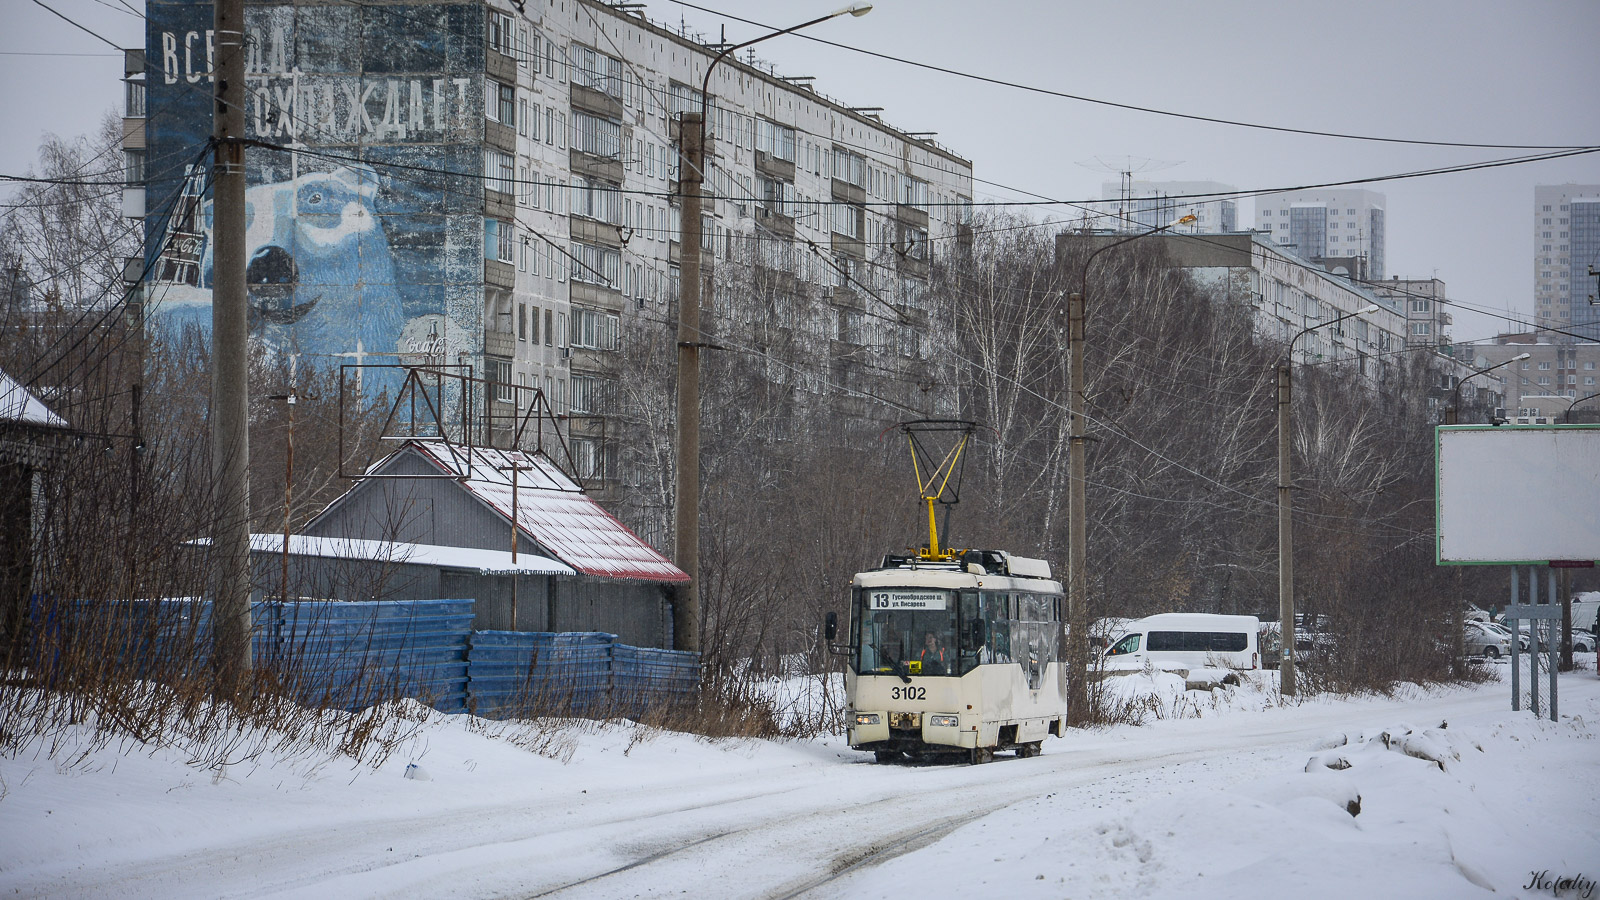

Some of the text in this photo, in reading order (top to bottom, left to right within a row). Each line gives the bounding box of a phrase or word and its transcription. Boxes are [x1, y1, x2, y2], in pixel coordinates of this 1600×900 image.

[162, 27, 288, 86] ВСЕДА
[253, 77, 471, 139] ОХЛАЖДАЕТ
[873, 593, 890, 608] 13
[900, 600, 926, 608] Писарева
[891, 686, 926, 700] 3102
